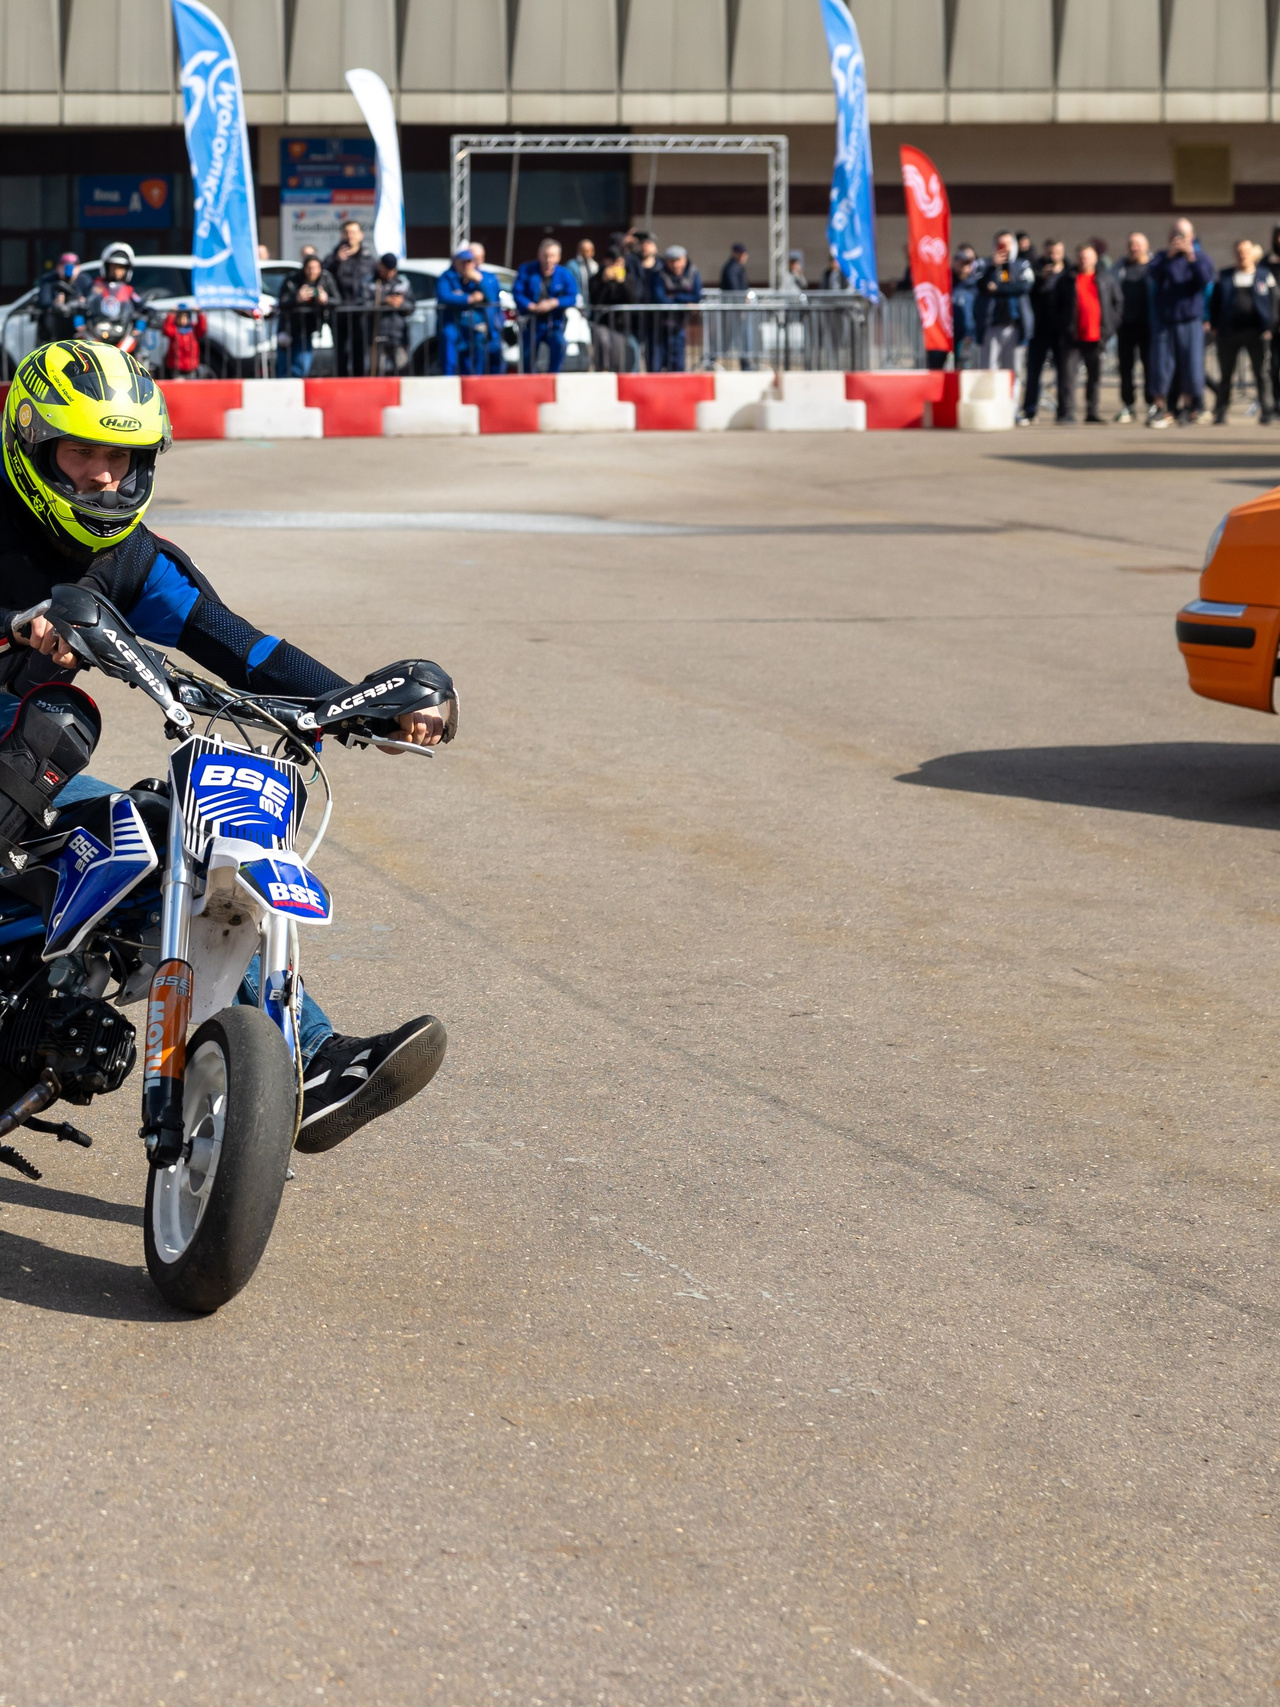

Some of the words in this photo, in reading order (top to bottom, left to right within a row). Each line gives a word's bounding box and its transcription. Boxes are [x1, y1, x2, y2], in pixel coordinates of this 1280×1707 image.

[106, 418, 139, 429] HJC
[199, 765, 290, 807] BSE
[68, 834, 99, 863] BSE
[268, 882, 324, 910] BSE
[153, 976, 190, 989] BSE
[144, 1000, 164, 1095] MOTUL
